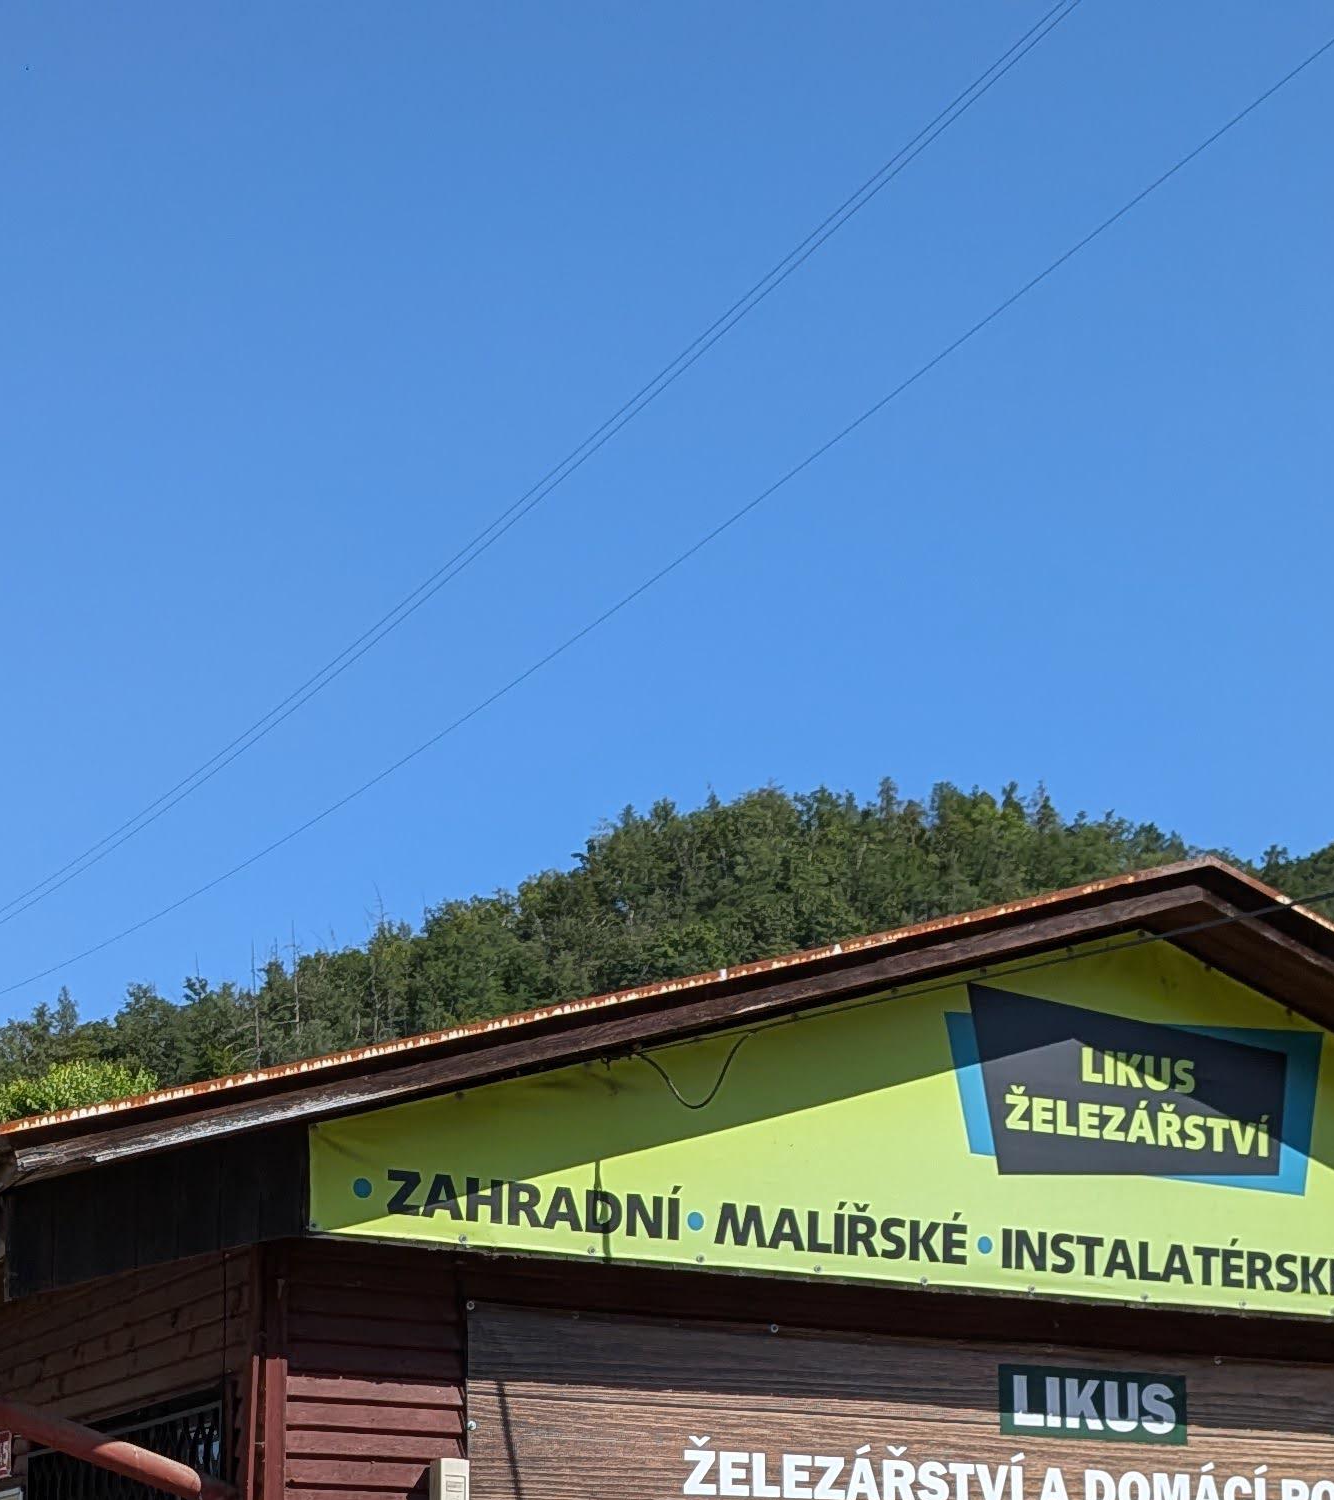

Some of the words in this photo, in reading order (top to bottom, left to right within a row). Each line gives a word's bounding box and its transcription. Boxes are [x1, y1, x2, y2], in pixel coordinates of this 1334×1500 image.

[1081, 1046, 1195, 1094] LIKUS
[1004, 1085, 1270, 1158] ŽELEZÁŘSTVÍ
[385, 1169, 681, 1241] ZAHRADNÍ
[714, 1201, 968, 1264] MALÍŘSKÉ
[1012, 1374, 1176, 1435] LIKUS
